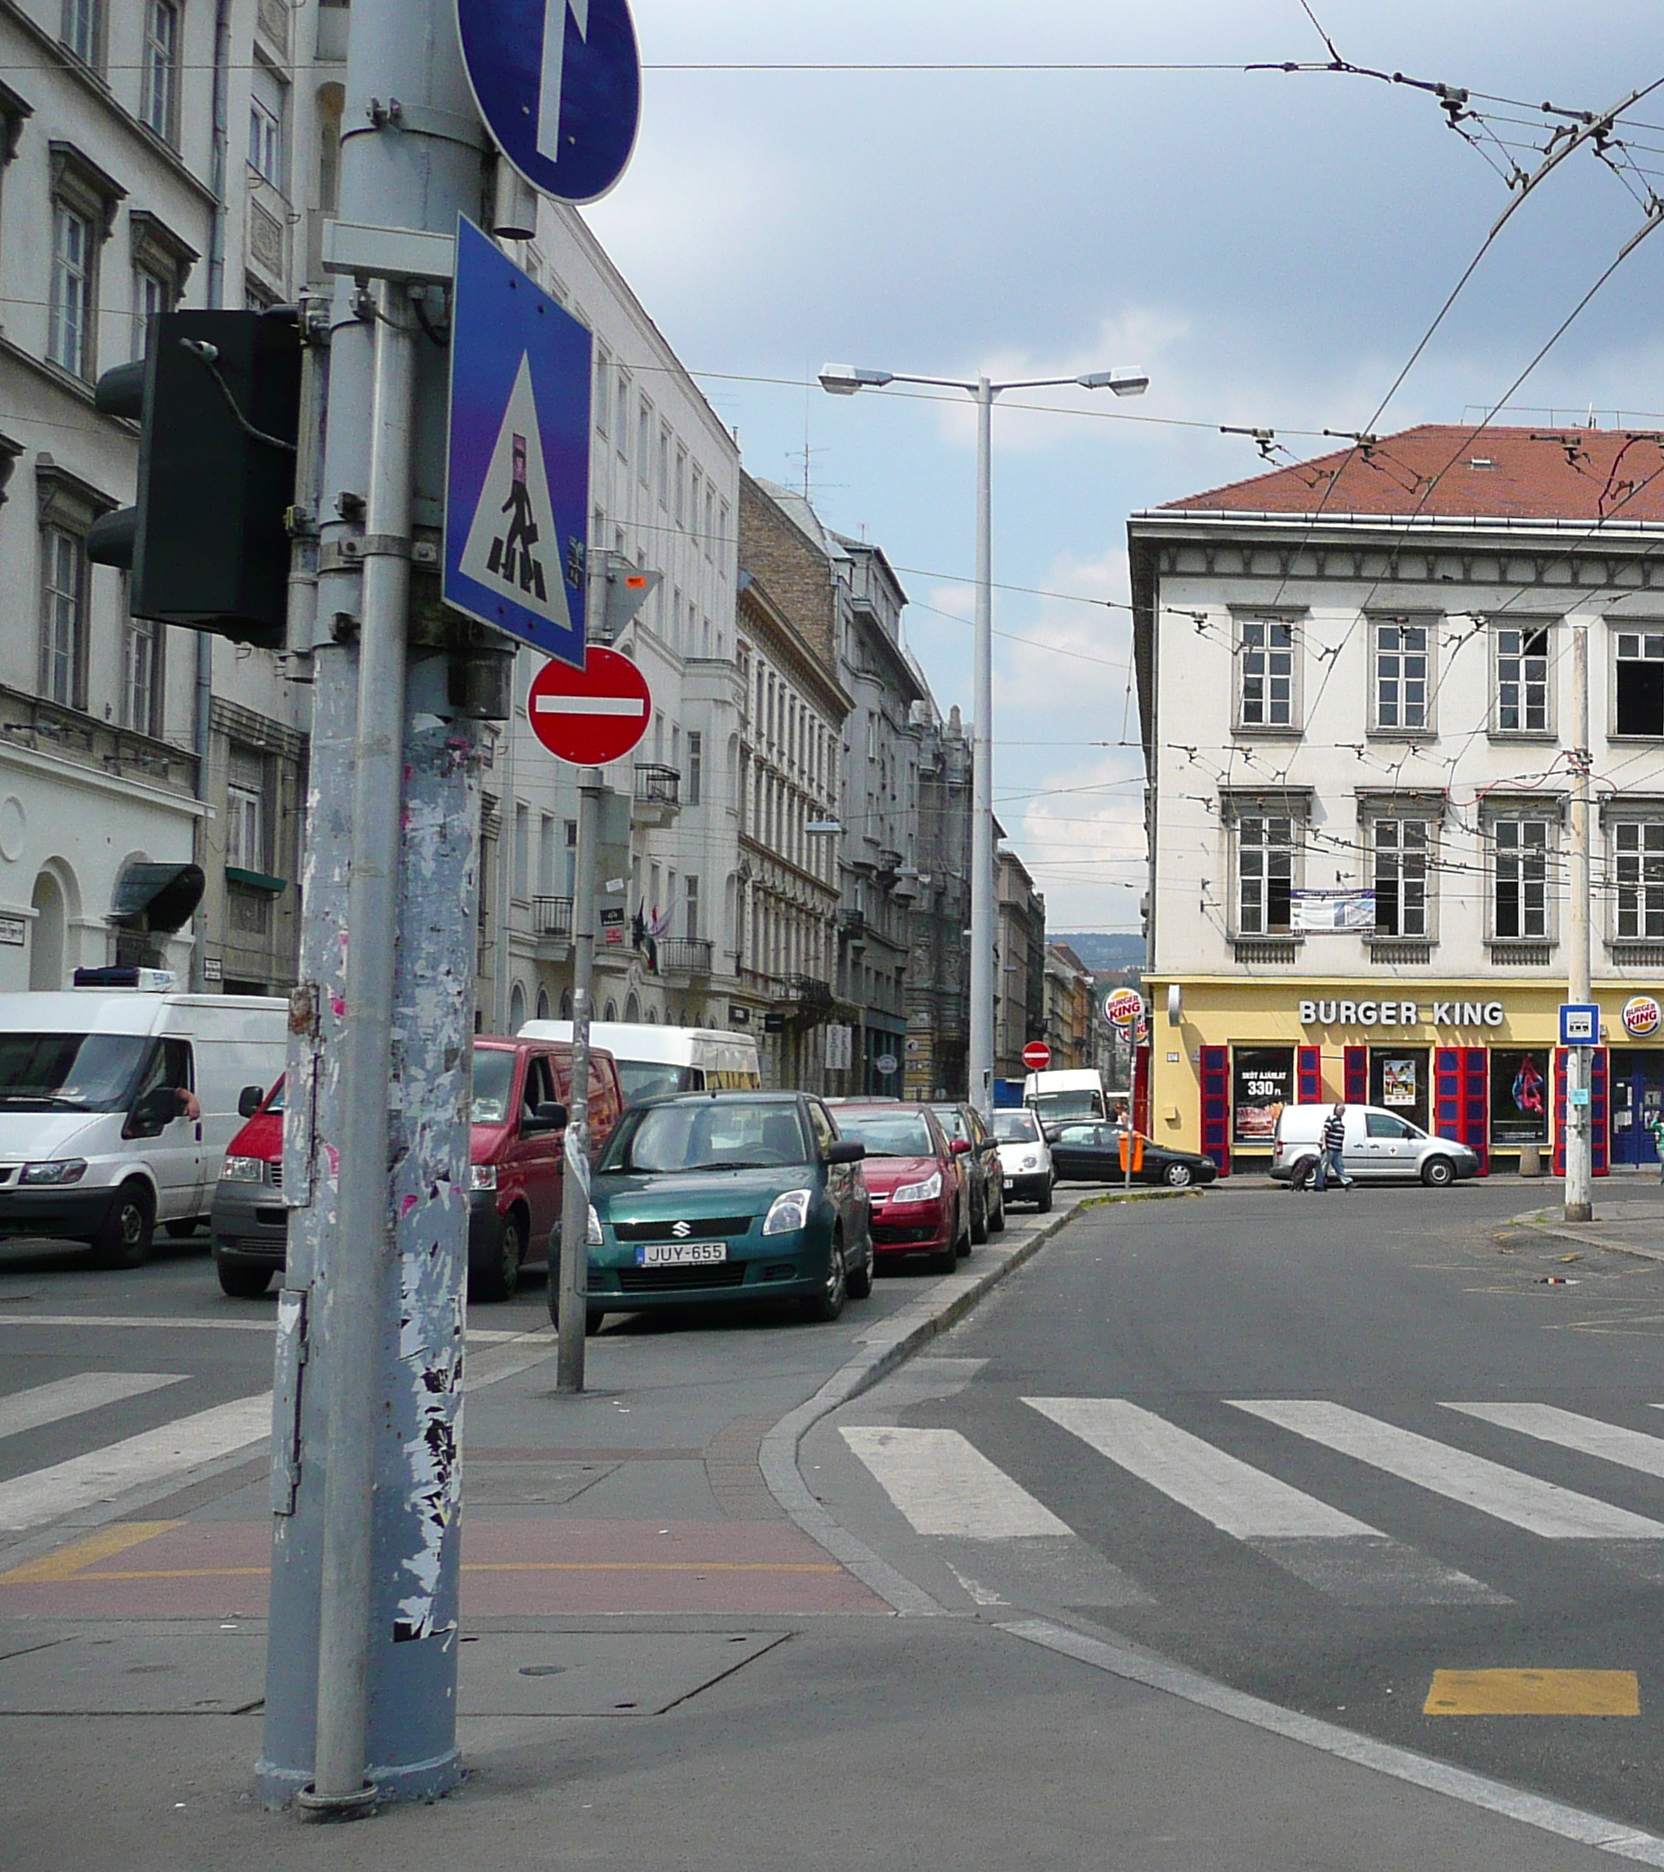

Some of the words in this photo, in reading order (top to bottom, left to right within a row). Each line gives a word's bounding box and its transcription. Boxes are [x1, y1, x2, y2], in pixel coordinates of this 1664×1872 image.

[1108, 995, 1139, 1011] BURGER
[1110, 1001, 1141, 1020] KING
[1626, 1003, 1656, 1018] BURGER
[1299, 1000, 1418, 1026] BURGER
[1433, 1001, 1505, 1027] KING
[1627, 1010, 1658, 1027] KING
[1247, 1080, 1274, 1096] 330
[648, 1244, 722, 1262] JUY-655
